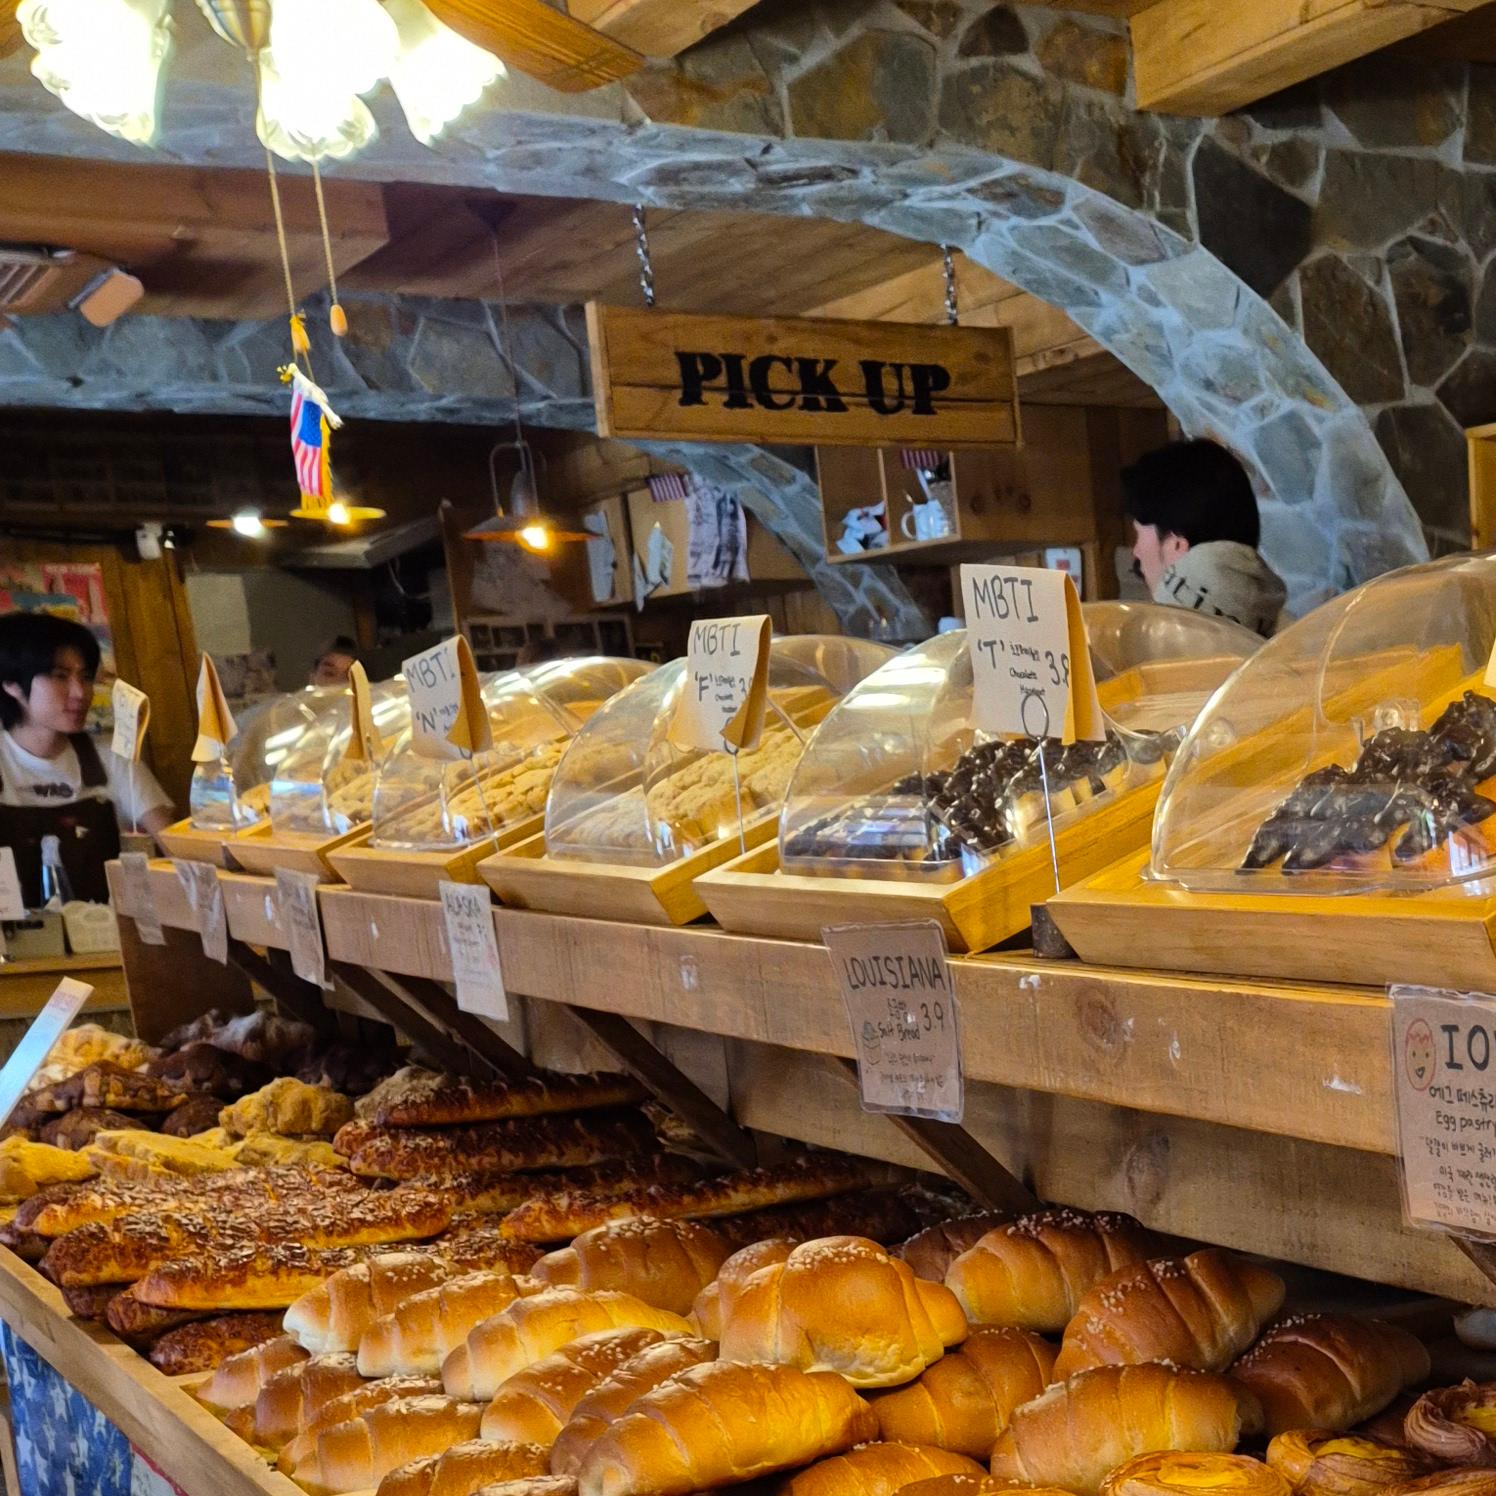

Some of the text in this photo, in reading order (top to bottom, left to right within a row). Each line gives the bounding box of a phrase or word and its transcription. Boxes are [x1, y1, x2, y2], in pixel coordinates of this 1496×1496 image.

[674, 350, 951, 416] PICK UP
[972, 575, 1038, 622] MBTI
[693, 623, 741, 656] MBTI
[843, 955, 947, 991] LOUISIANA
[898, 1022, 920, 1041] Bread
[1428, 1085, 1454, 1105] 에그
[1435, 1110, 1456, 1132] Egg
